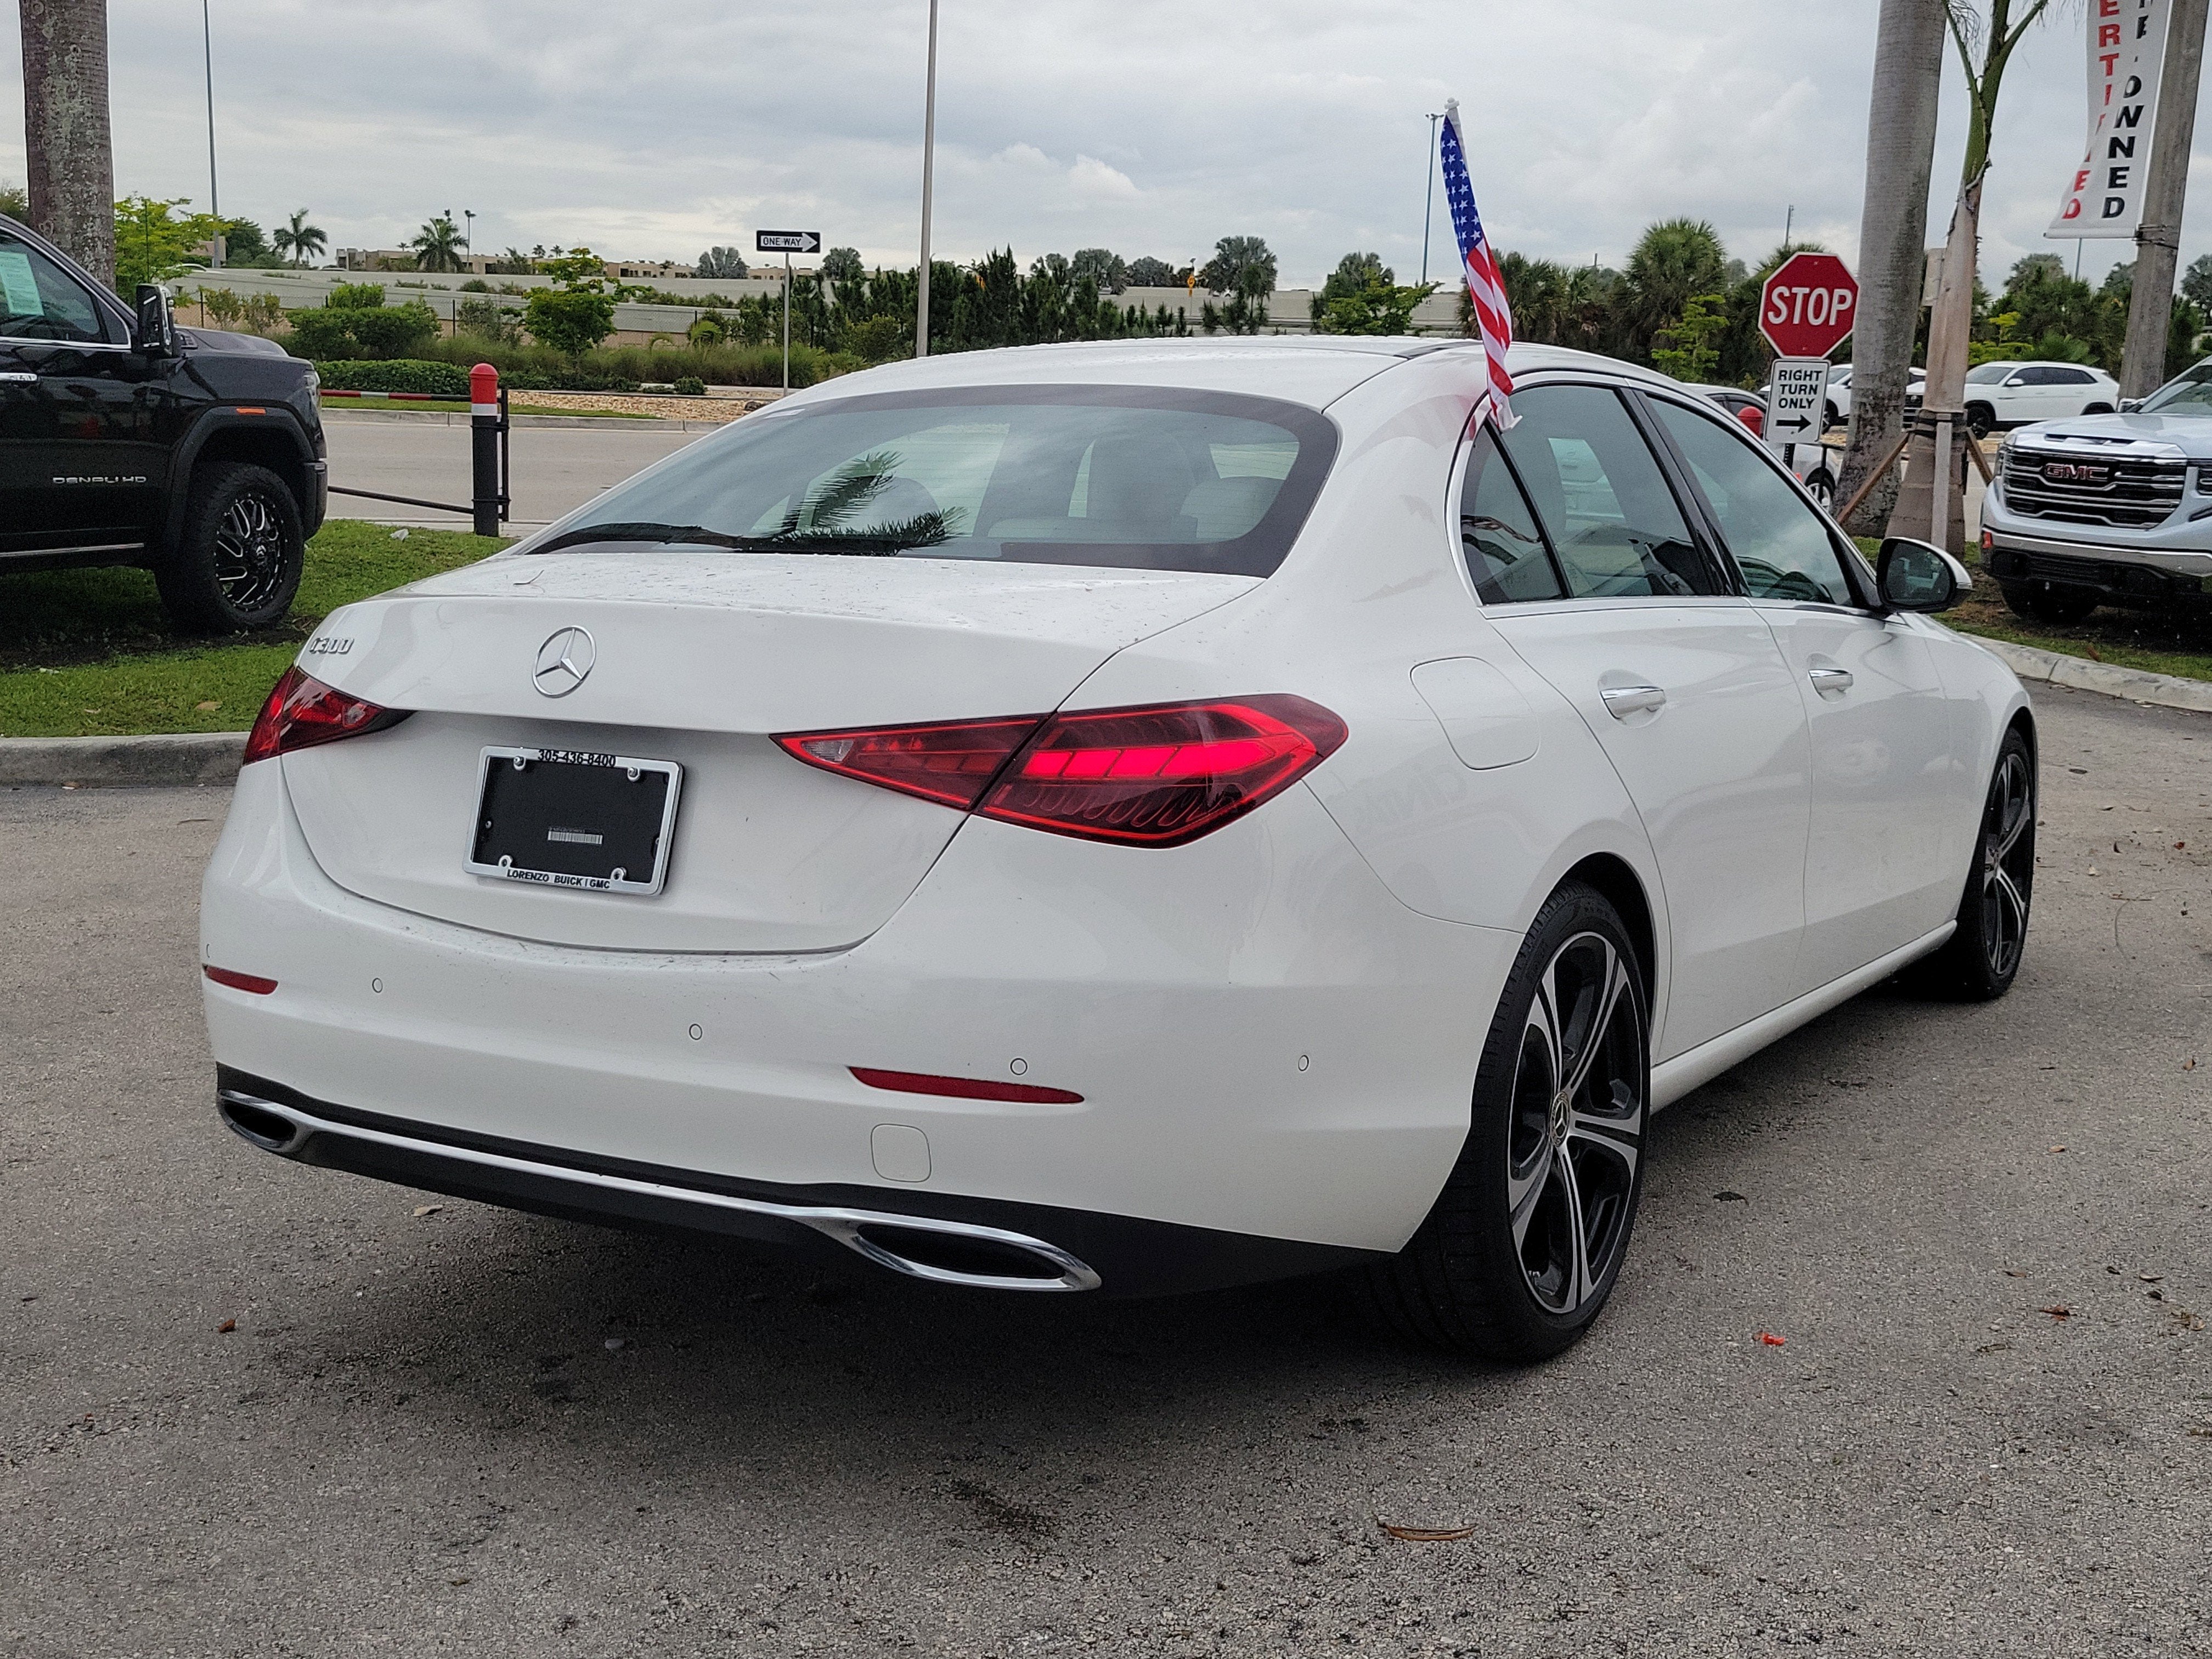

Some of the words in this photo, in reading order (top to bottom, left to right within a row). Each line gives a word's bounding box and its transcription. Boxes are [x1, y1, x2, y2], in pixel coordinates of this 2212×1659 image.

[2062, 0, 2120, 220] ERTIED
[763, 236, 780, 246] ONE
[783, 238, 802, 246] WAY
[1767, 286, 1853, 326] STOP
[1778, 370, 1822, 381] RIGHT
[1780, 384, 1818, 396] TURN
[1778, 398, 1816, 409] ONLY
[2045, 462, 2109, 482] GMC
[538, 749, 616, 768] 305-436-8400
[506, 869, 549, 882] LORENZO
[554, 874, 583, 887] BUICK
[589, 879, 611, 889] GMC
